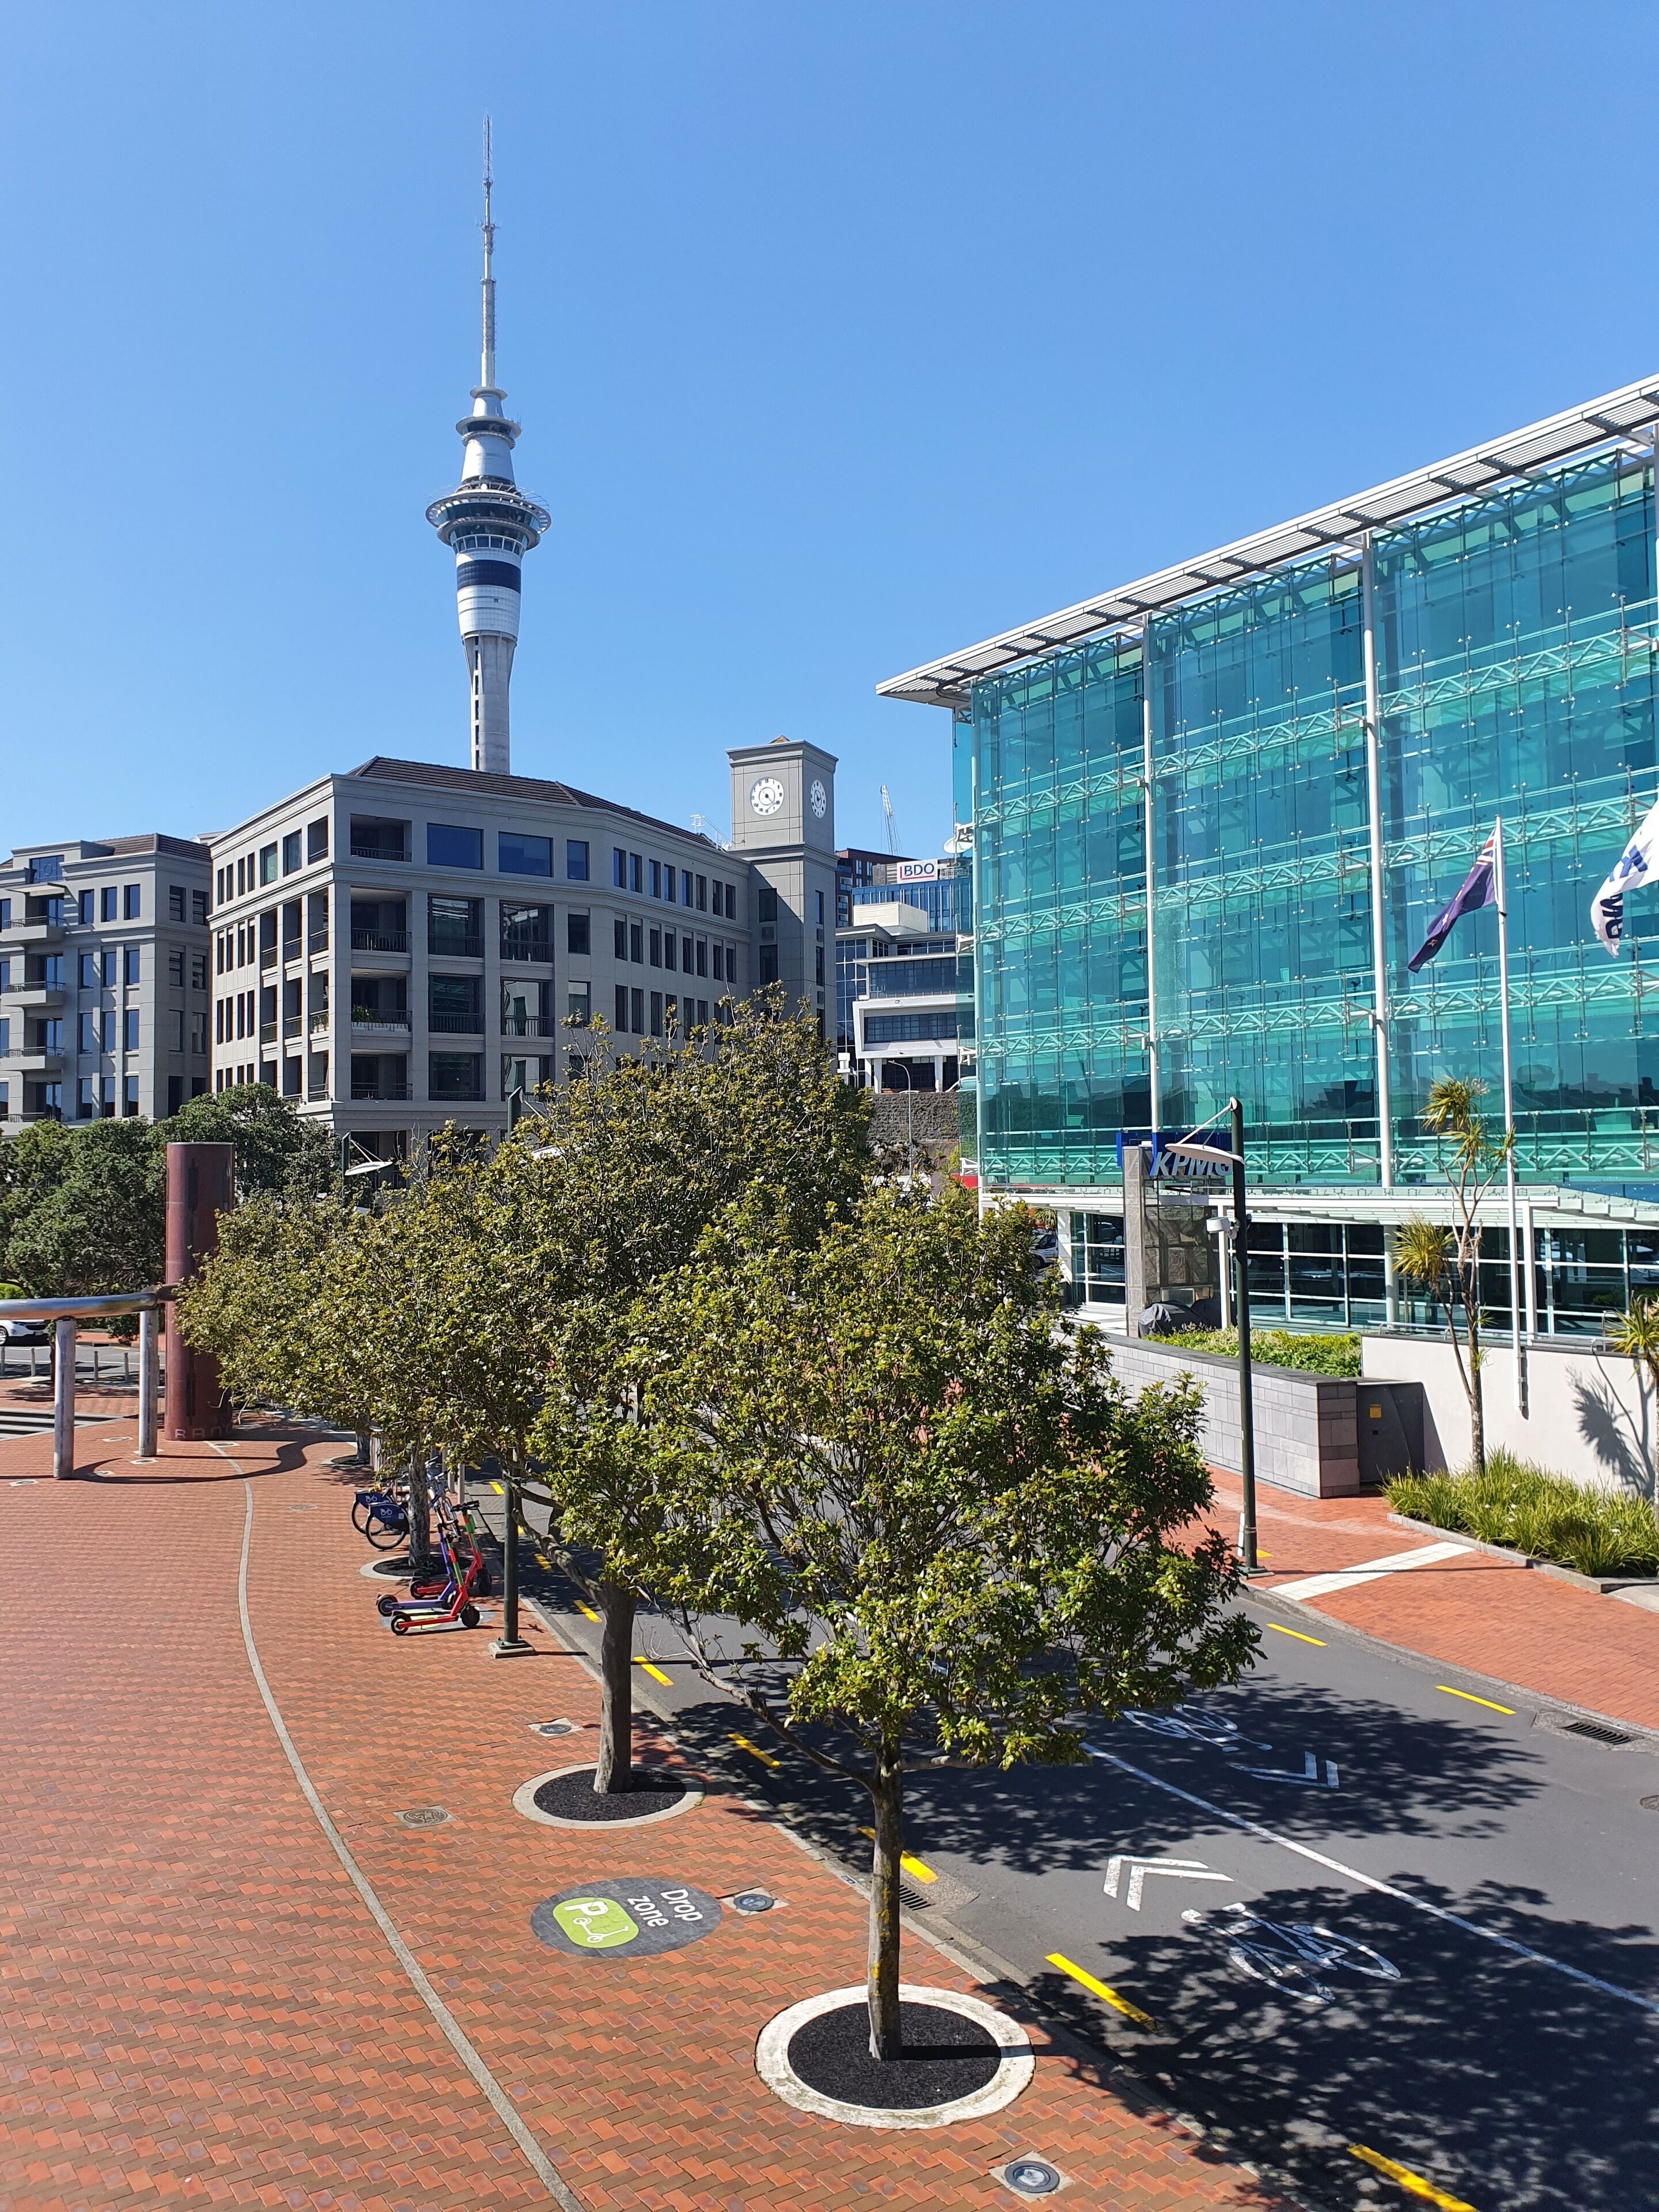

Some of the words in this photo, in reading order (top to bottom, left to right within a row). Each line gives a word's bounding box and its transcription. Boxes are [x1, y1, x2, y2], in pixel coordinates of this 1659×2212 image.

[904, 863, 935, 876] BDO
[1152, 1151, 1234, 1176] KPMG
[564, 1900, 609, 1916] P
[627, 1895, 669, 1927] zone
[660, 1888, 704, 1922] Drop
